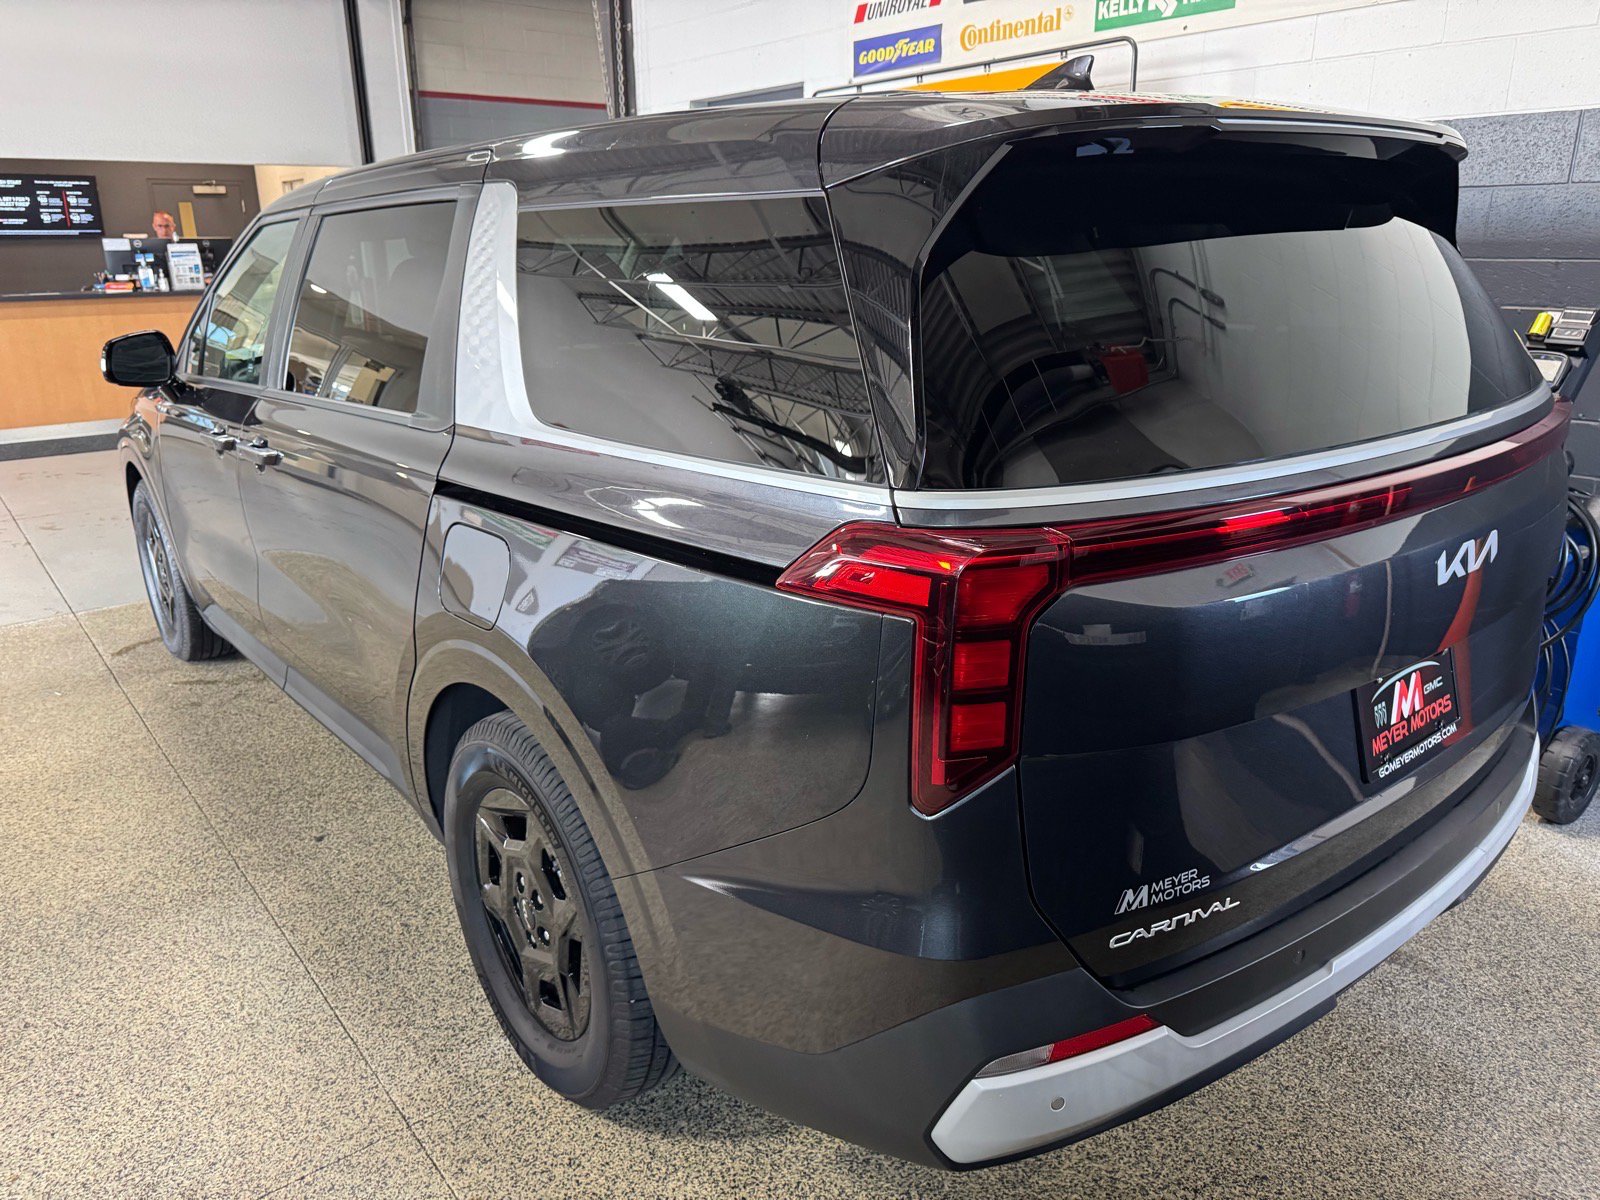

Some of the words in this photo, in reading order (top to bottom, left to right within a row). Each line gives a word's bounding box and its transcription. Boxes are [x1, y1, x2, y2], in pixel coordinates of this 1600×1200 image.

[960, 7, 1062, 52] Continental
[1098, 0, 1145, 20] KELLY
[858, 38, 936, 65] GOODYEAR
[1437, 529, 1499, 586] KIA
[1423, 676, 1444, 695] GMC
[1371, 720, 1409, 757] MEYER
[1410, 693, 1453, 734] MOTORS
[1378, 722, 1458, 779] GOMEYERMOTORS.COM
[508, 769, 559, 847] MICHELIN
[1150, 868, 1198, 894] MEYER
[1150, 875, 1211, 906] MOTORS
[1109, 897, 1241, 949] CARNIVAL
